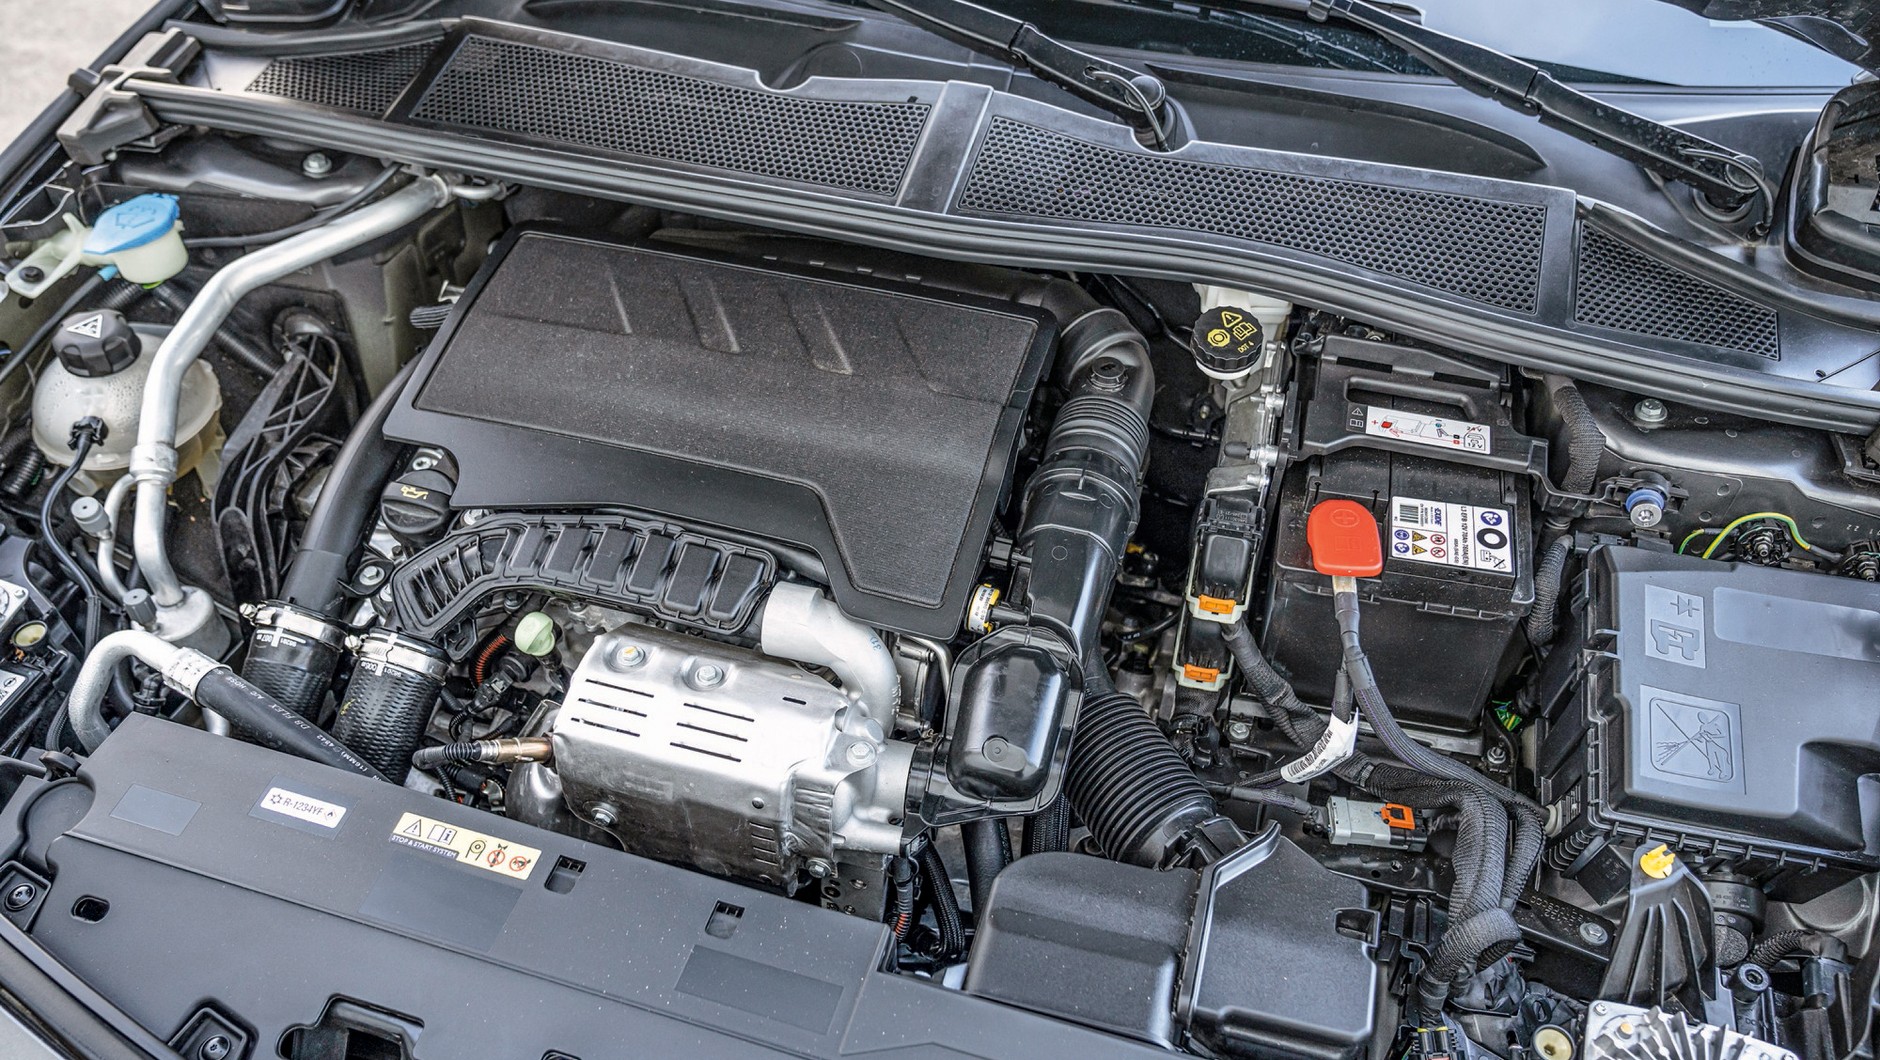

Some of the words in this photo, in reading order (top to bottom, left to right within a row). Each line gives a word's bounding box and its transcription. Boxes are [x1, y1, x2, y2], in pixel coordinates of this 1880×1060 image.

[1237, 343, 1249, 353] DOT
[1434, 507, 1442, 527] EXIDE
[268, 703, 296, 720] FLEX
[283, 798, 324, 816] R-1234YF
[391, 834, 408, 844] STOP
[413, 841, 433, 851] START
[432, 846, 457, 858] SYSTEM
